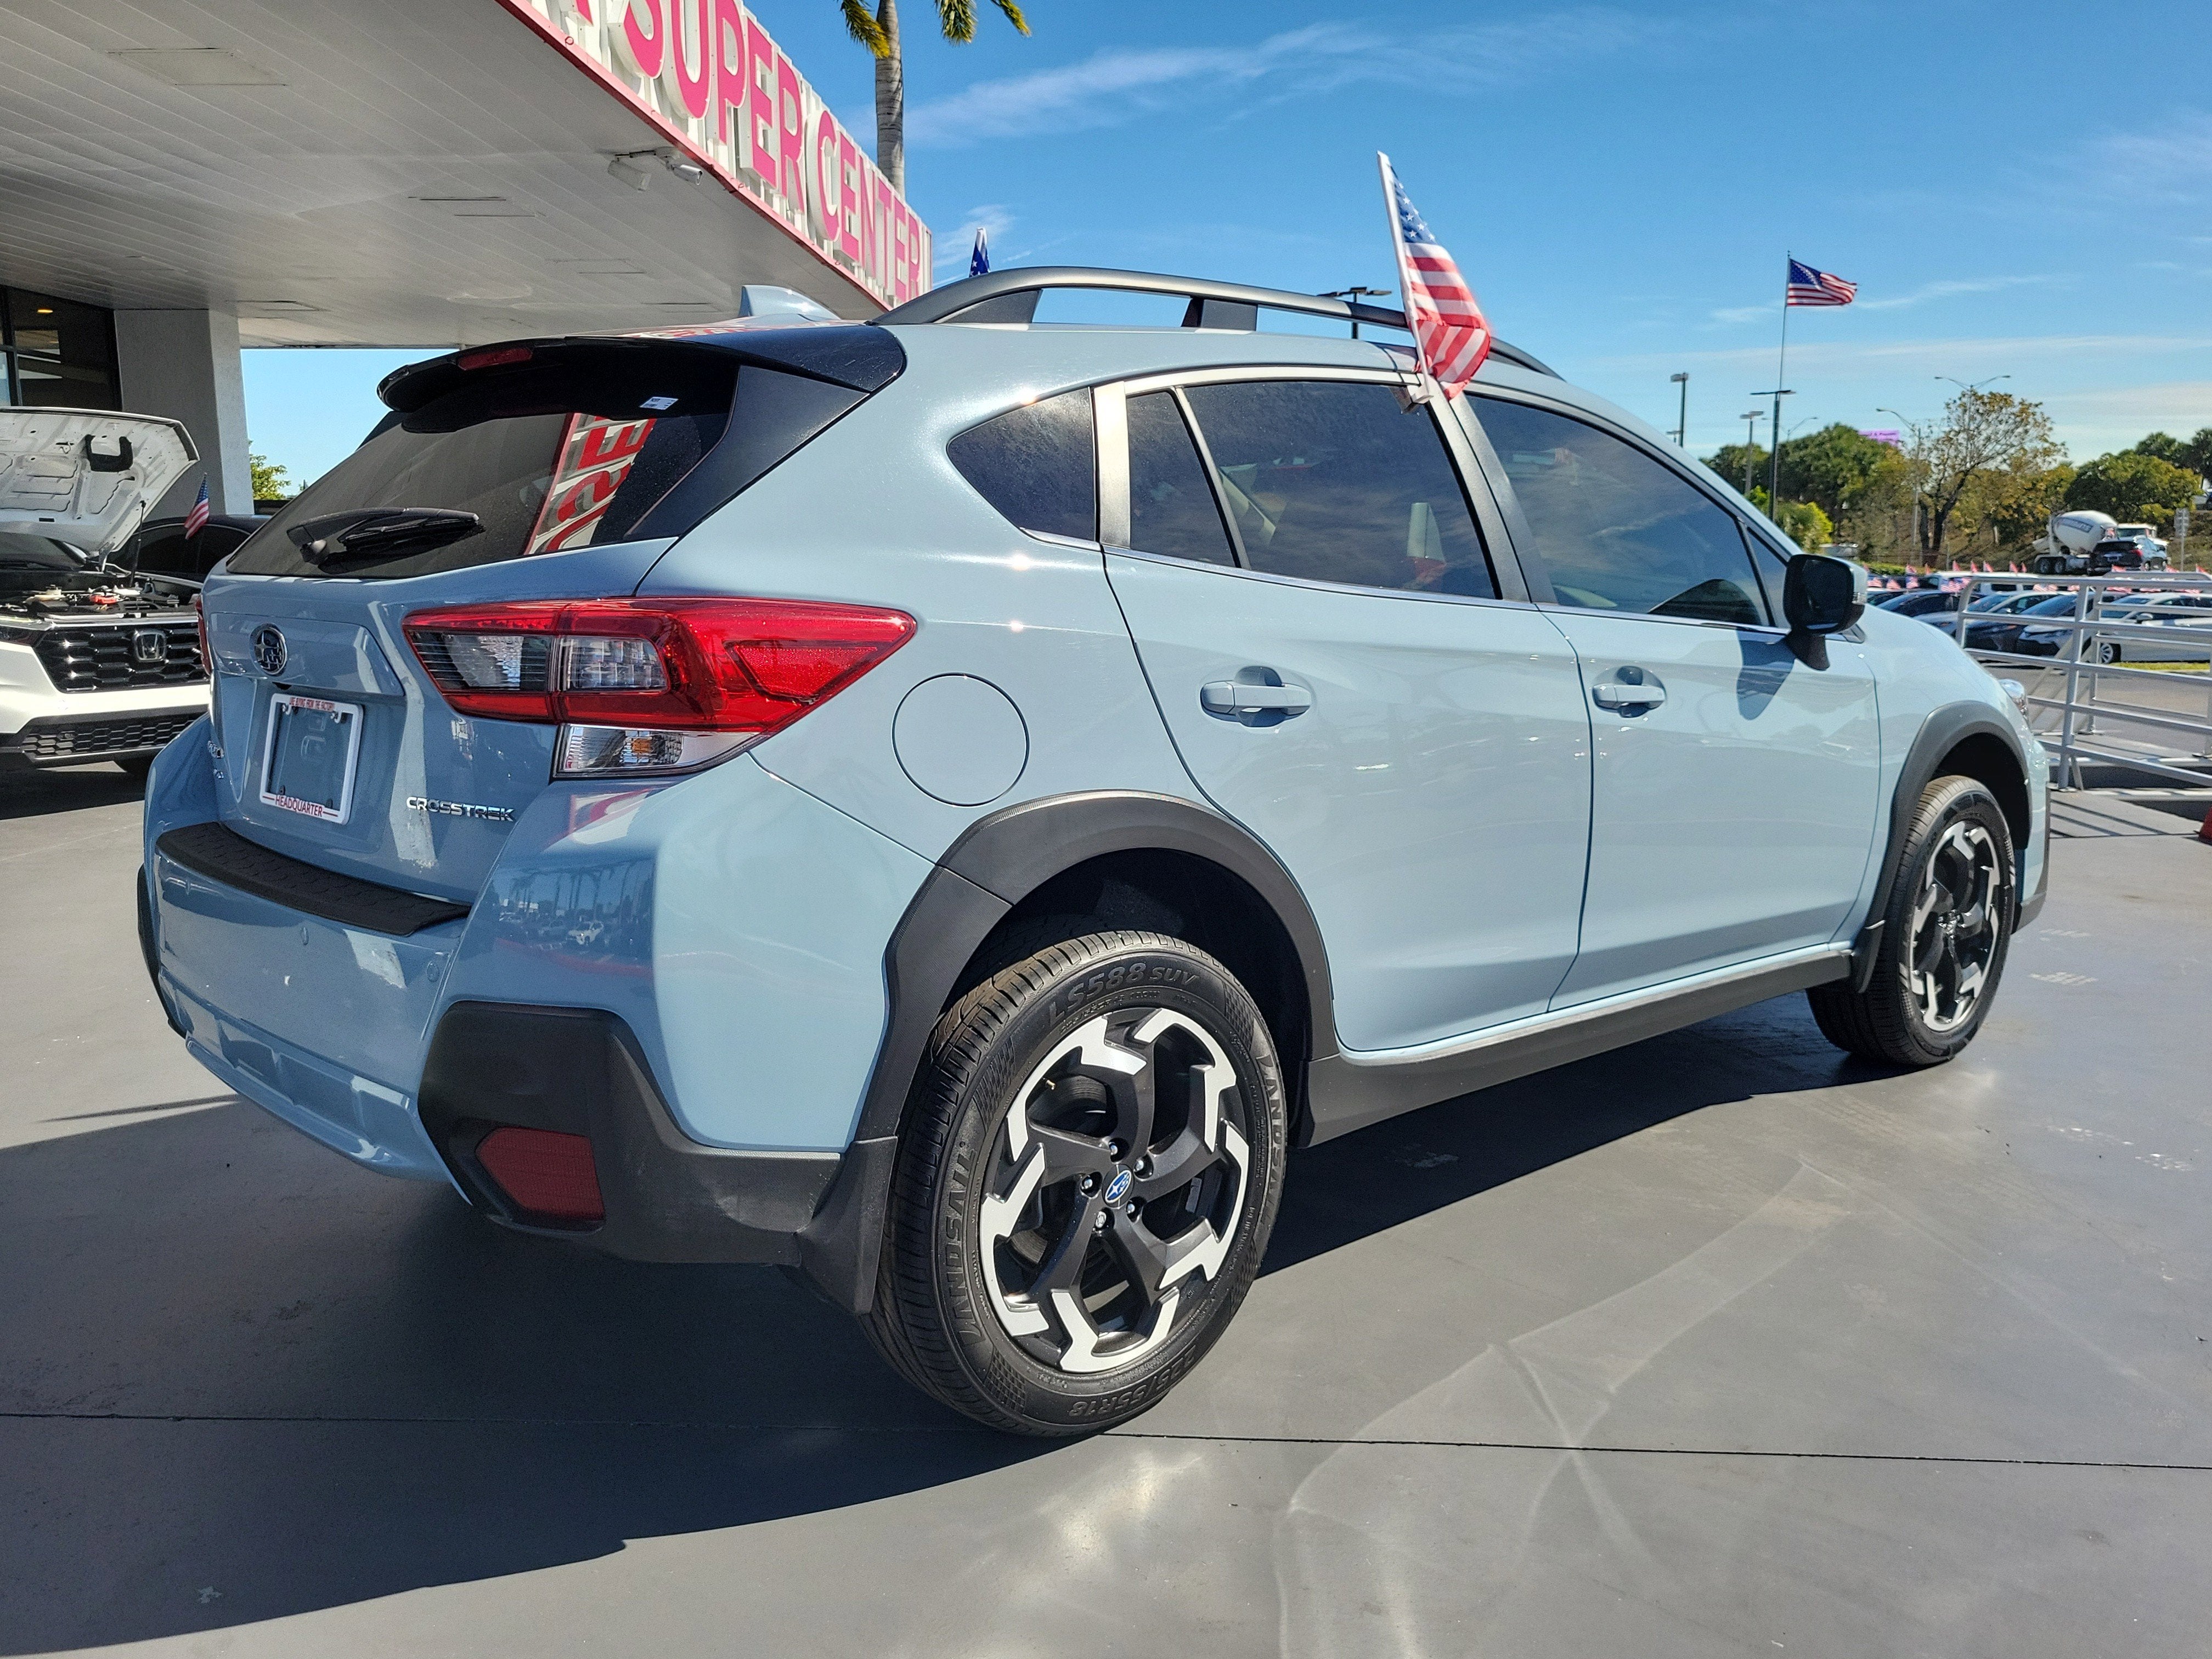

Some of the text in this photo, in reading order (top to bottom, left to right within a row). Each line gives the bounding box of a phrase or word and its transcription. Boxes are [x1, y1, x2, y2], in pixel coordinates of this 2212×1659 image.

[275, 795, 323, 817] HEADQUARTER
[406, 797, 515, 822] CROSSTREK
[1048, 962, 1200, 1027] LS588 SUV
[1069, 1344, 1197, 1417] 225/55R18
